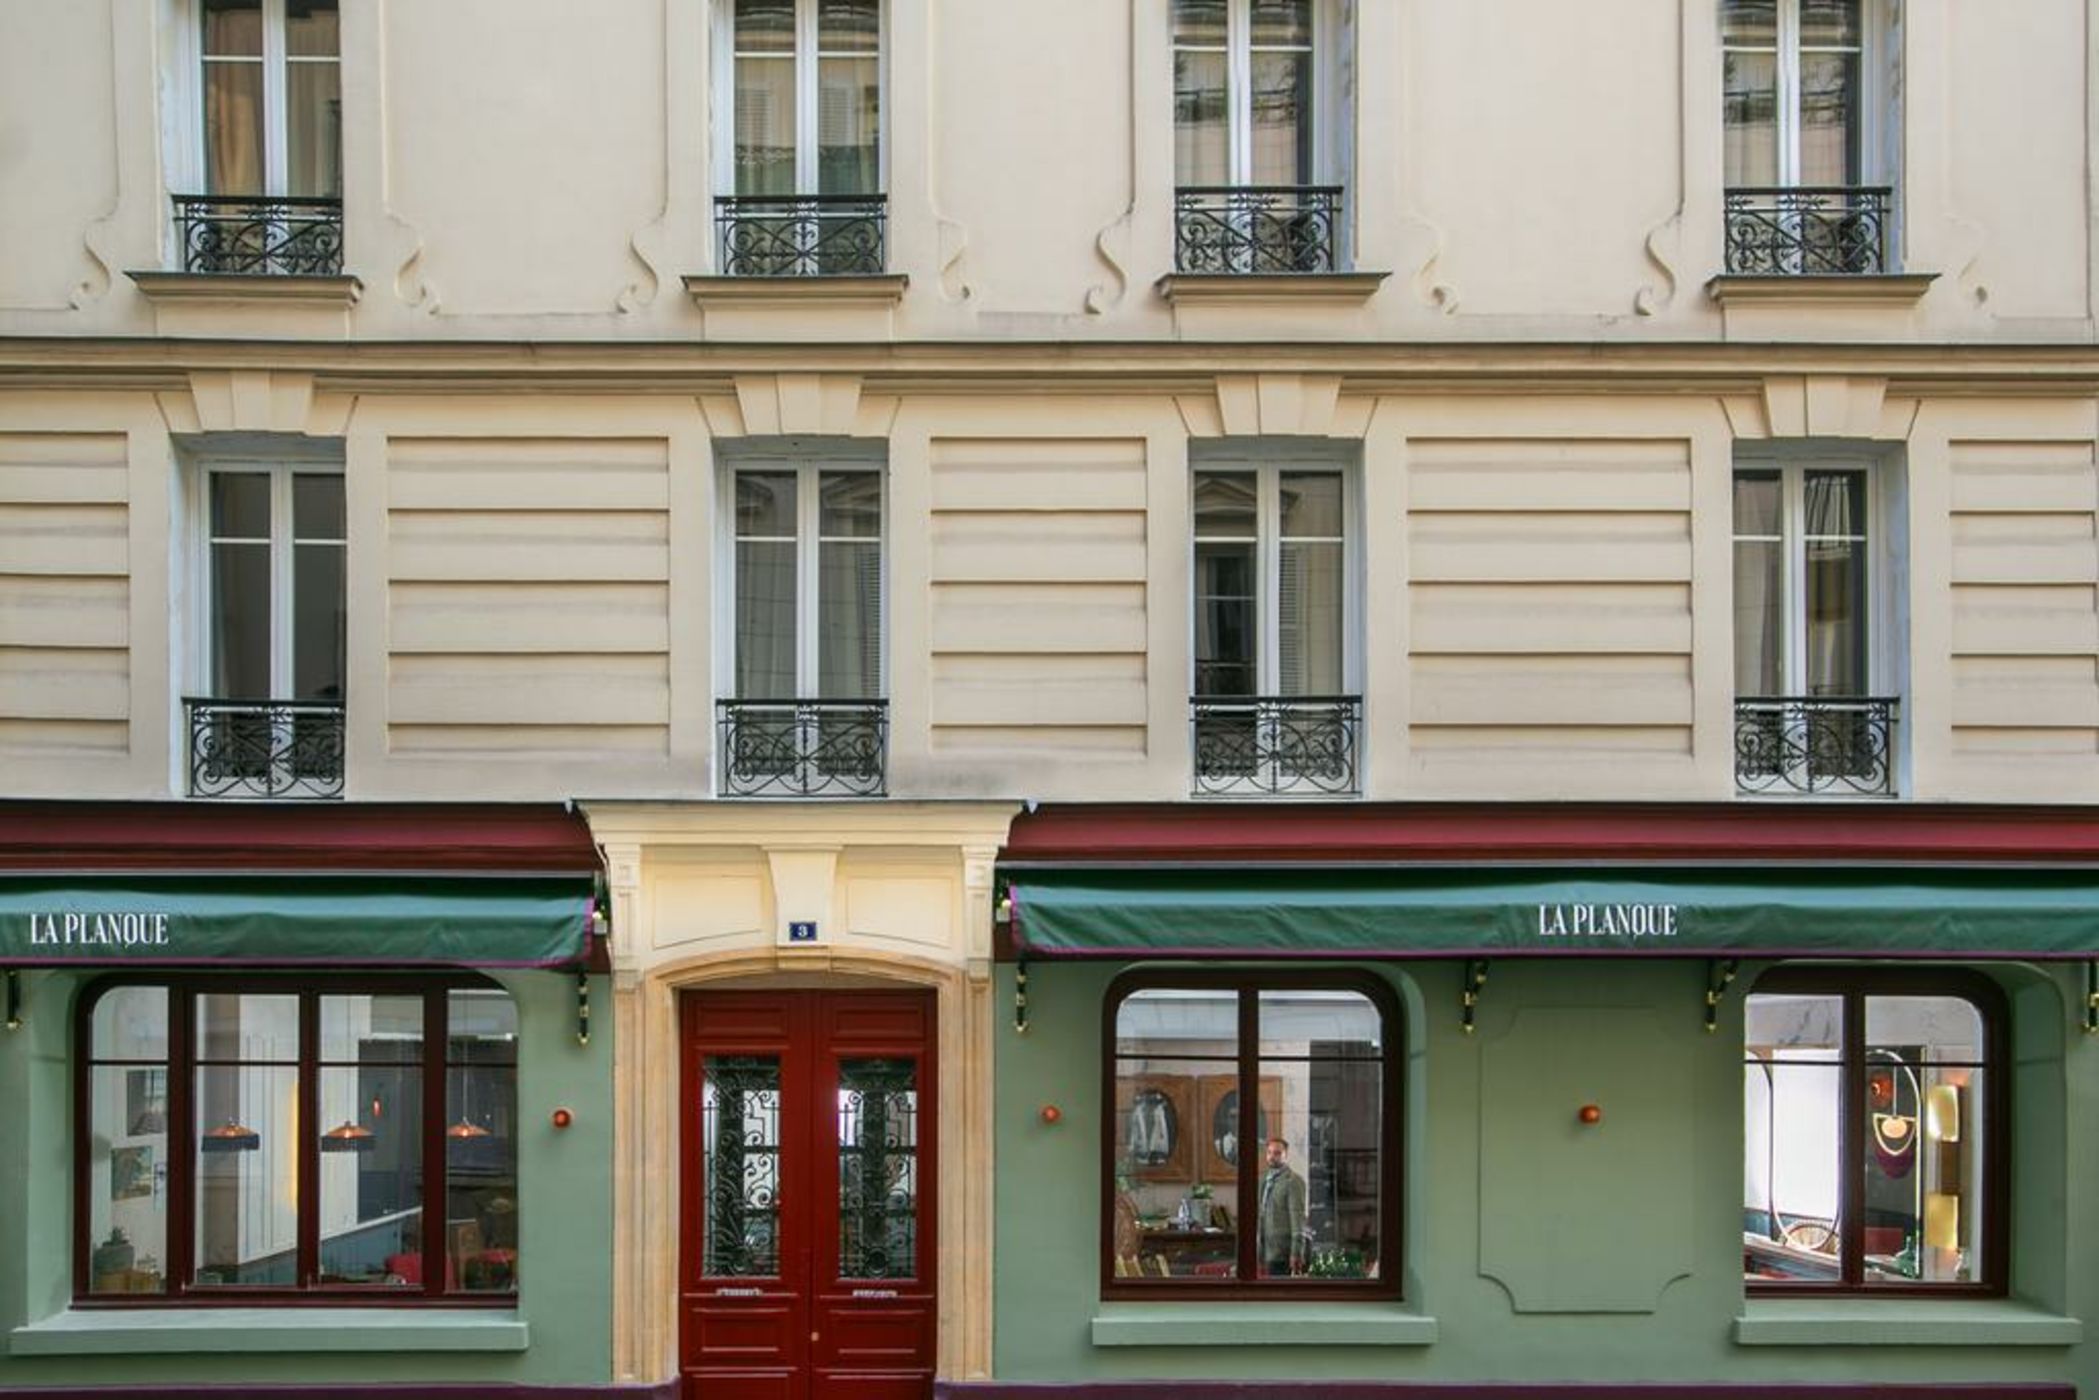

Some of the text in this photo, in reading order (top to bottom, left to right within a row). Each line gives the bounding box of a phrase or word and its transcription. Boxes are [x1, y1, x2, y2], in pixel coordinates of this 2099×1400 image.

[31, 913, 169, 948] LA PLANQUE
[798, 924, 808, 937] 3
[1540, 904, 1677, 940] LA PLANQUE
